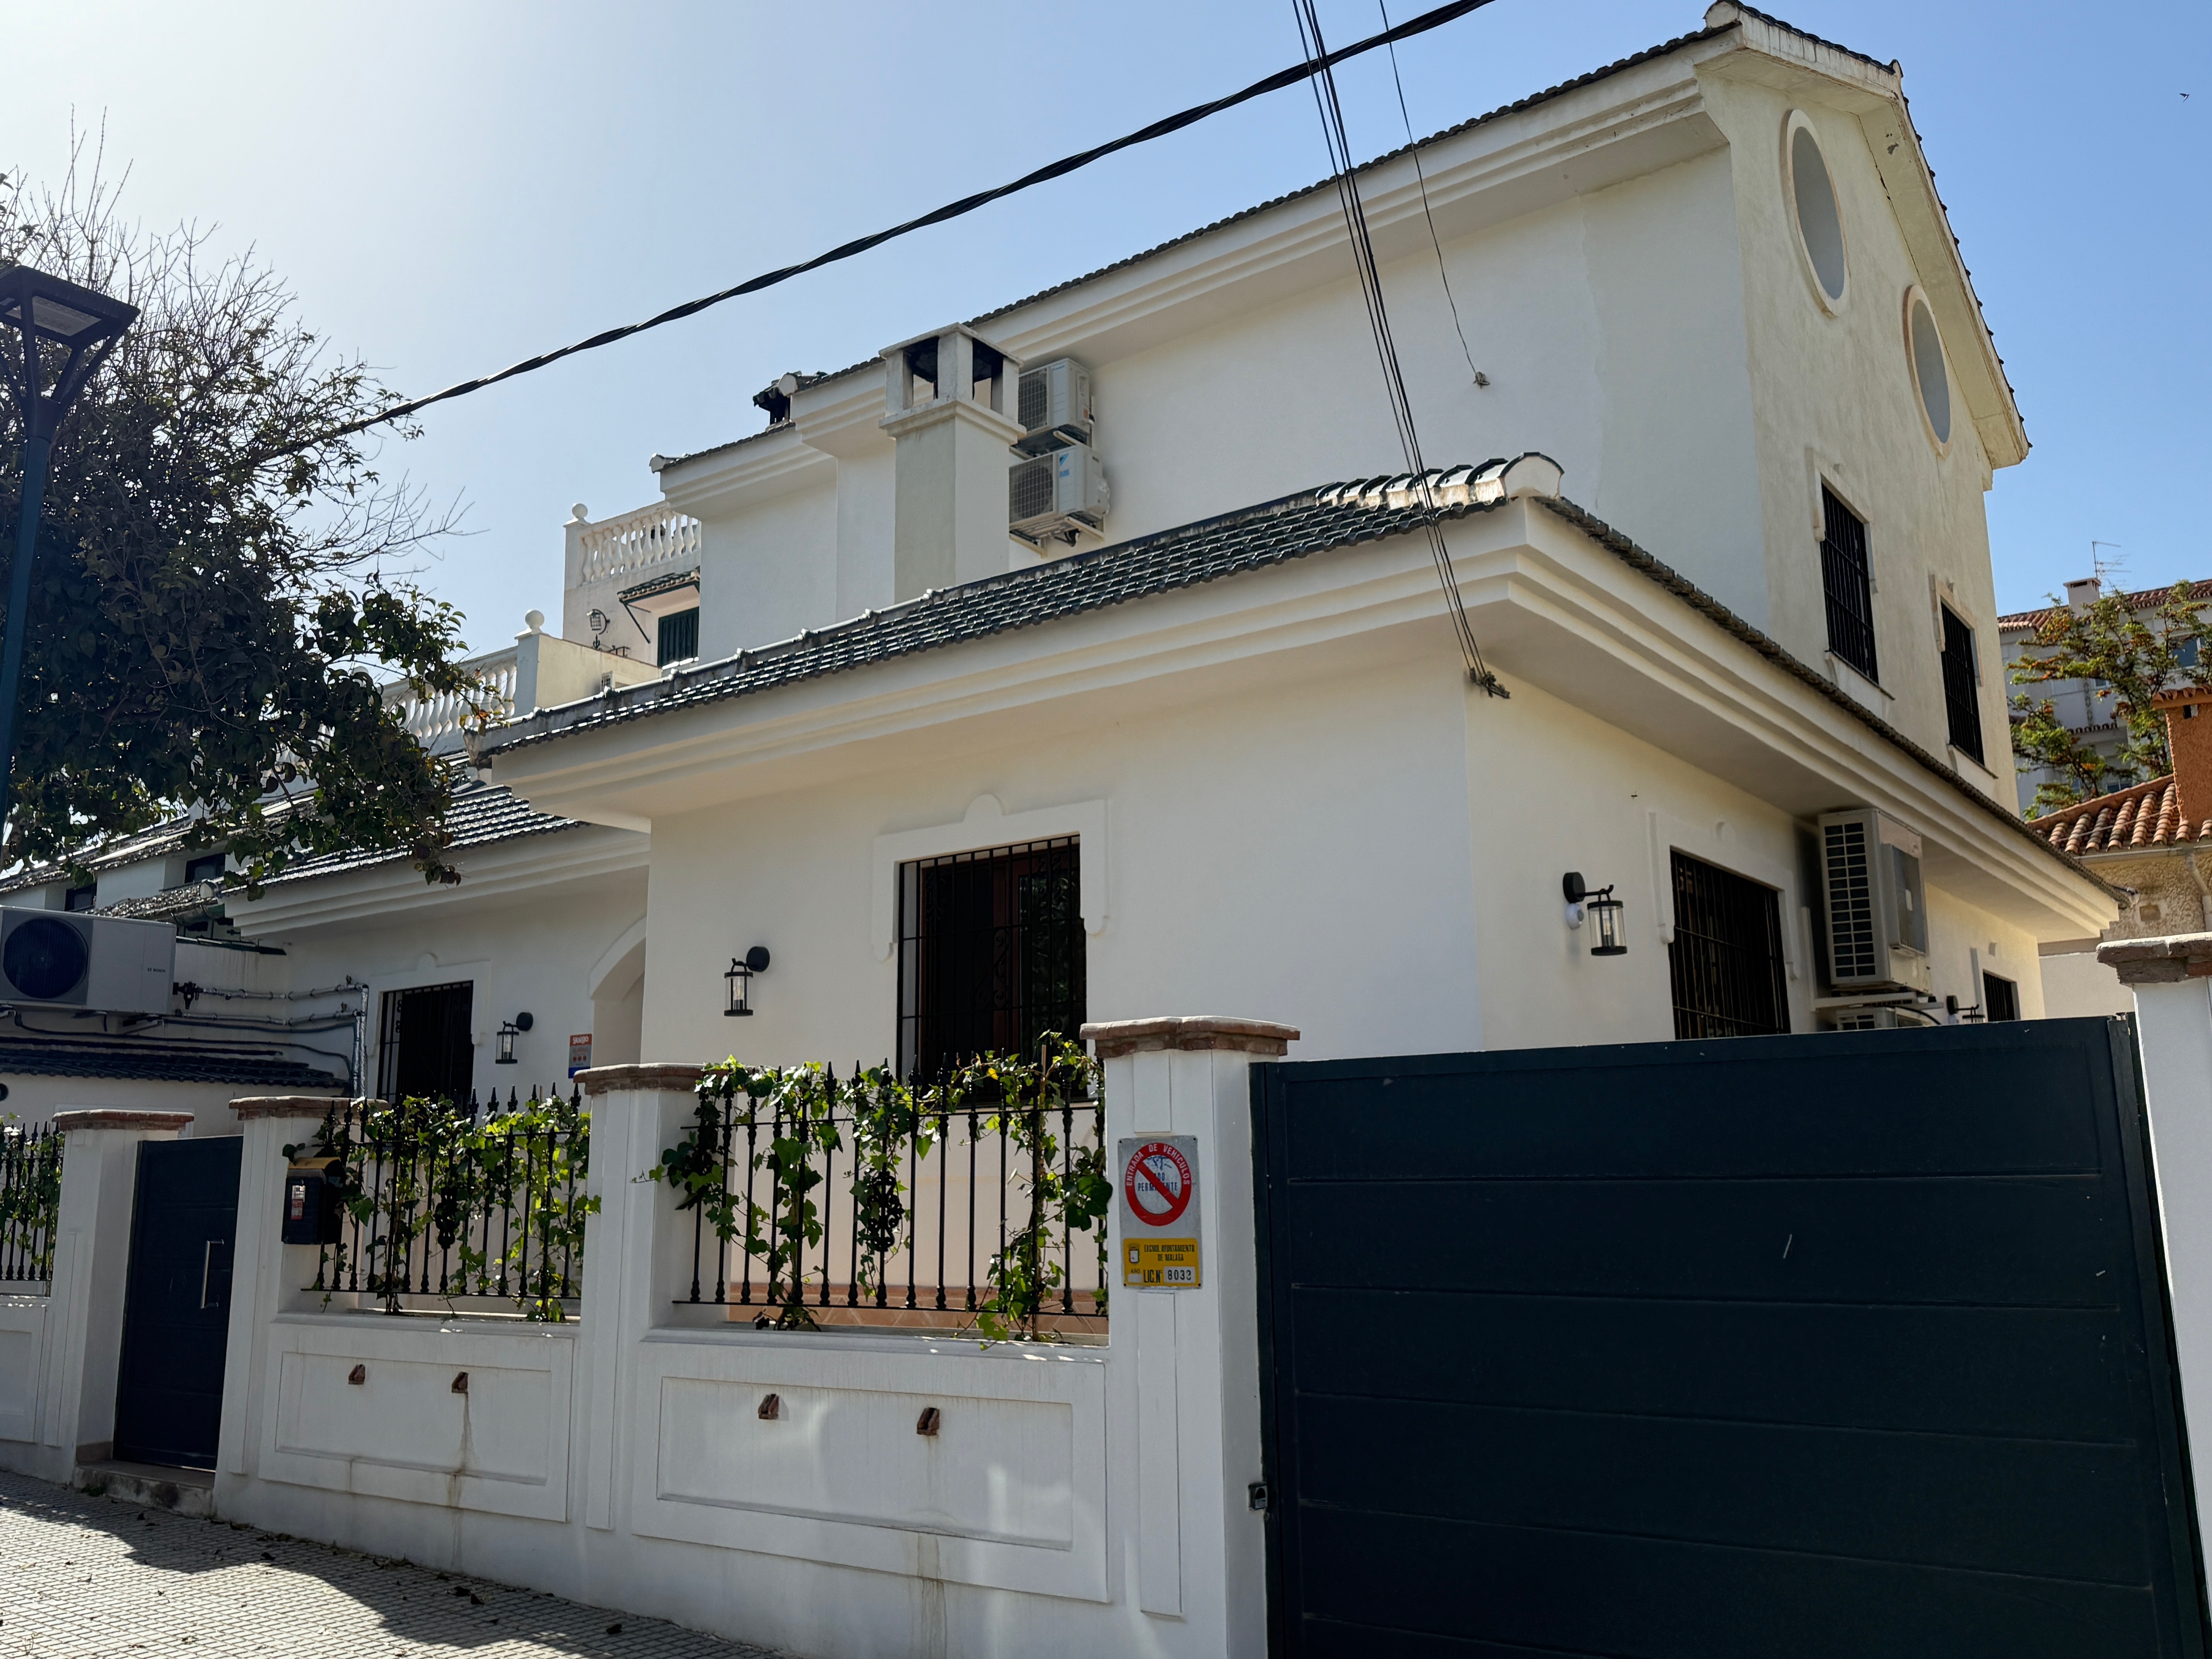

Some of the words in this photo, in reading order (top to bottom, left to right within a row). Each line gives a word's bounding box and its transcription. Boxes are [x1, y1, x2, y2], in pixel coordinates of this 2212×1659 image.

[1126, 1151, 1144, 1186] ENTRADA
[1149, 1144, 1158, 1152] DE
[1163, 1144, 1190, 1185] VEHICULOS
[1138, 1182, 1177, 1191] PERMNTE
